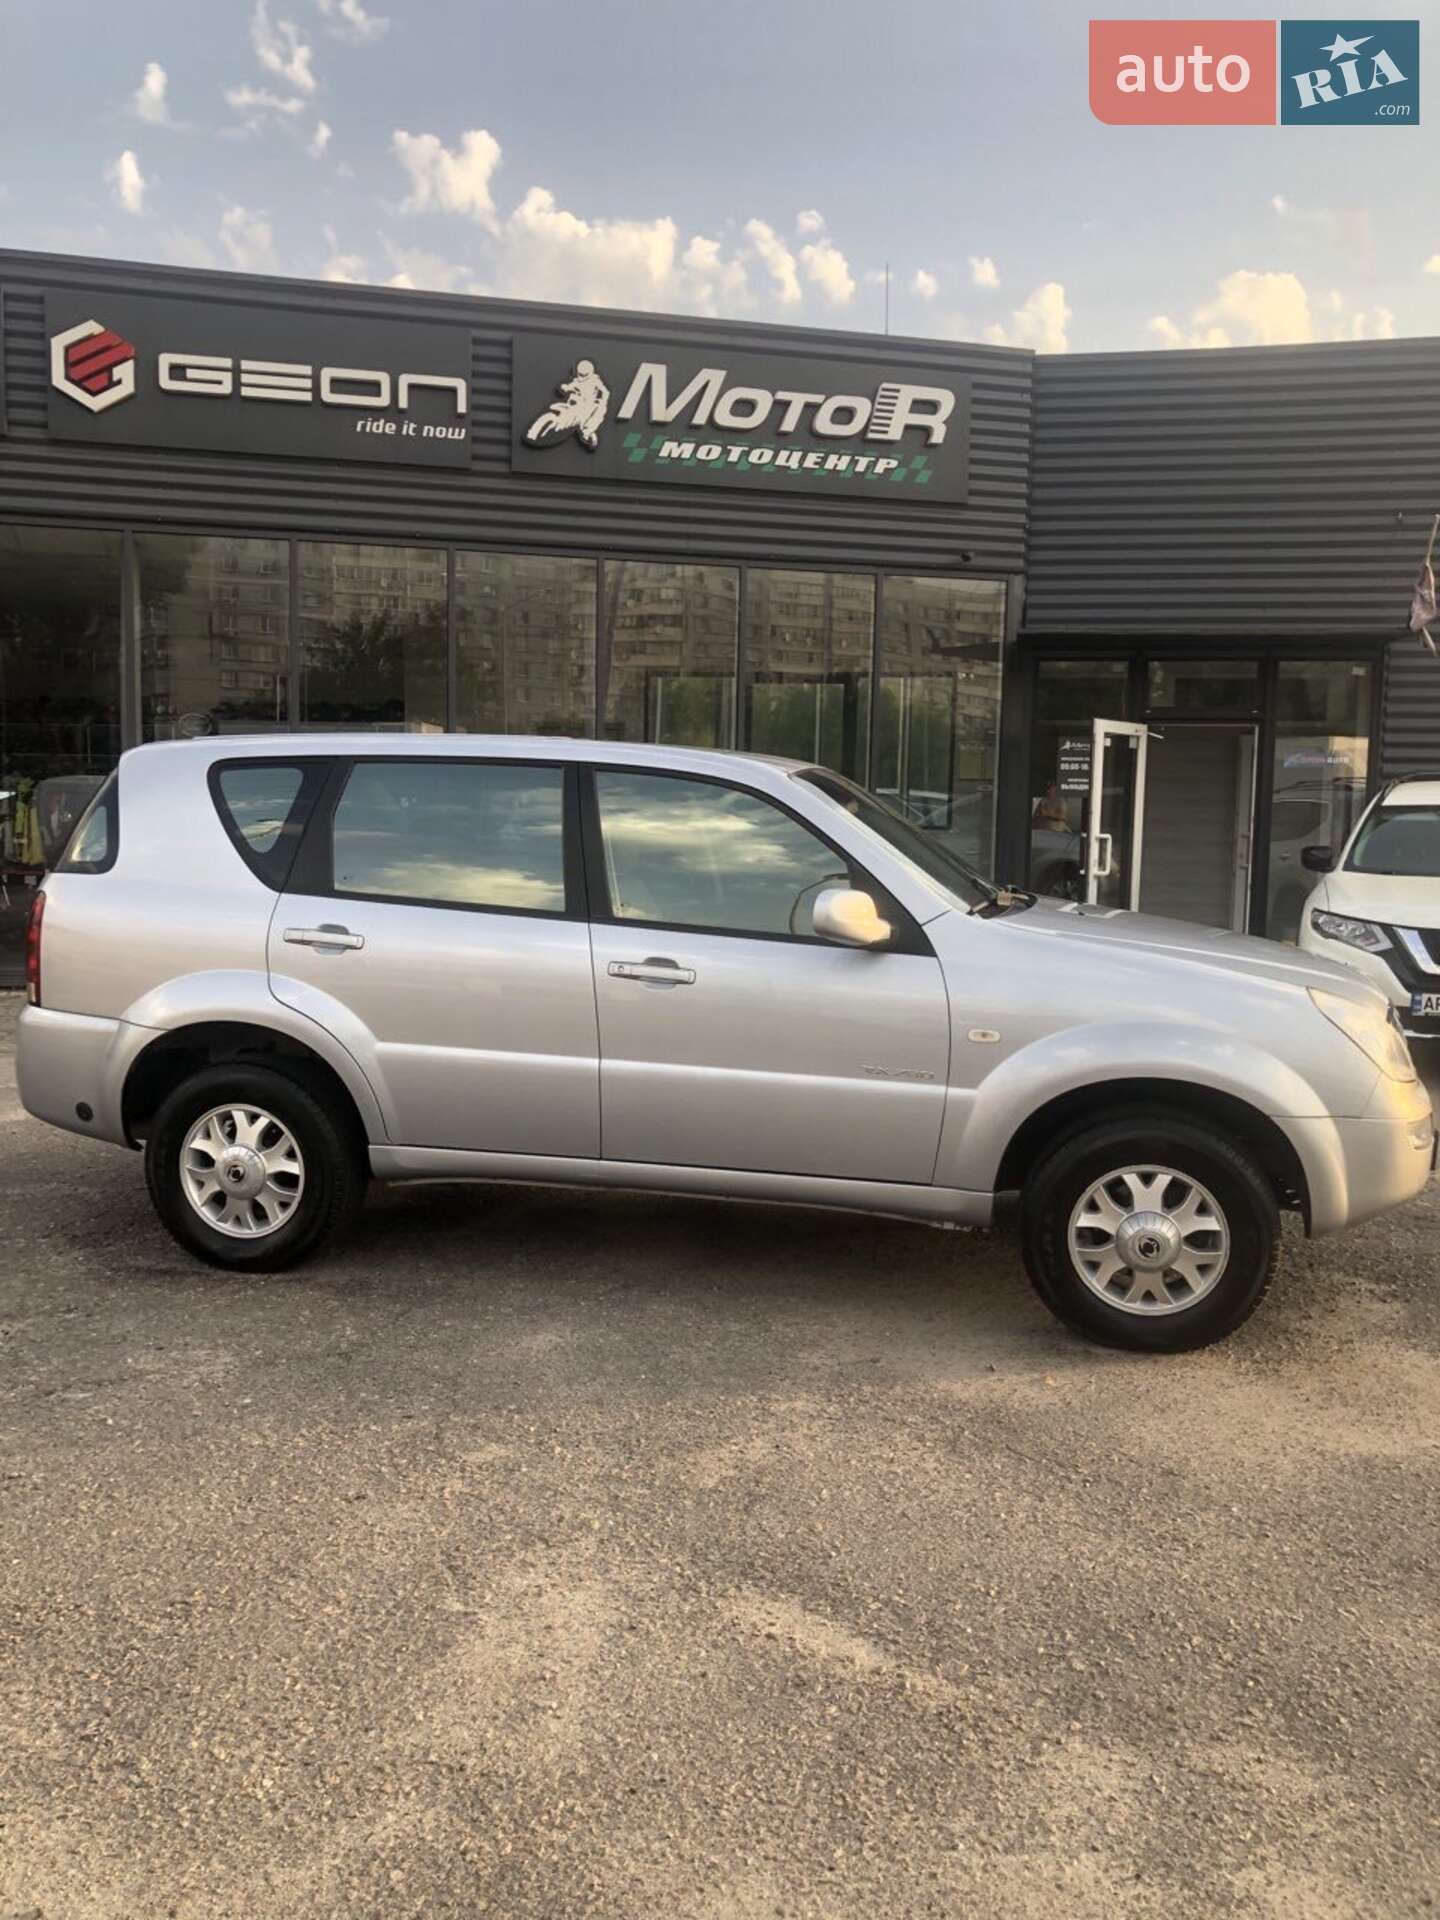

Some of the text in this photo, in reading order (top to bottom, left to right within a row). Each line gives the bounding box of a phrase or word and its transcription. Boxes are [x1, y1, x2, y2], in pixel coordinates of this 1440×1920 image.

[158, 352, 467, 414] GEON
[356, 417, 466, 440] ride it now
[658, 440, 899, 475] МОТОЦЕНТР
